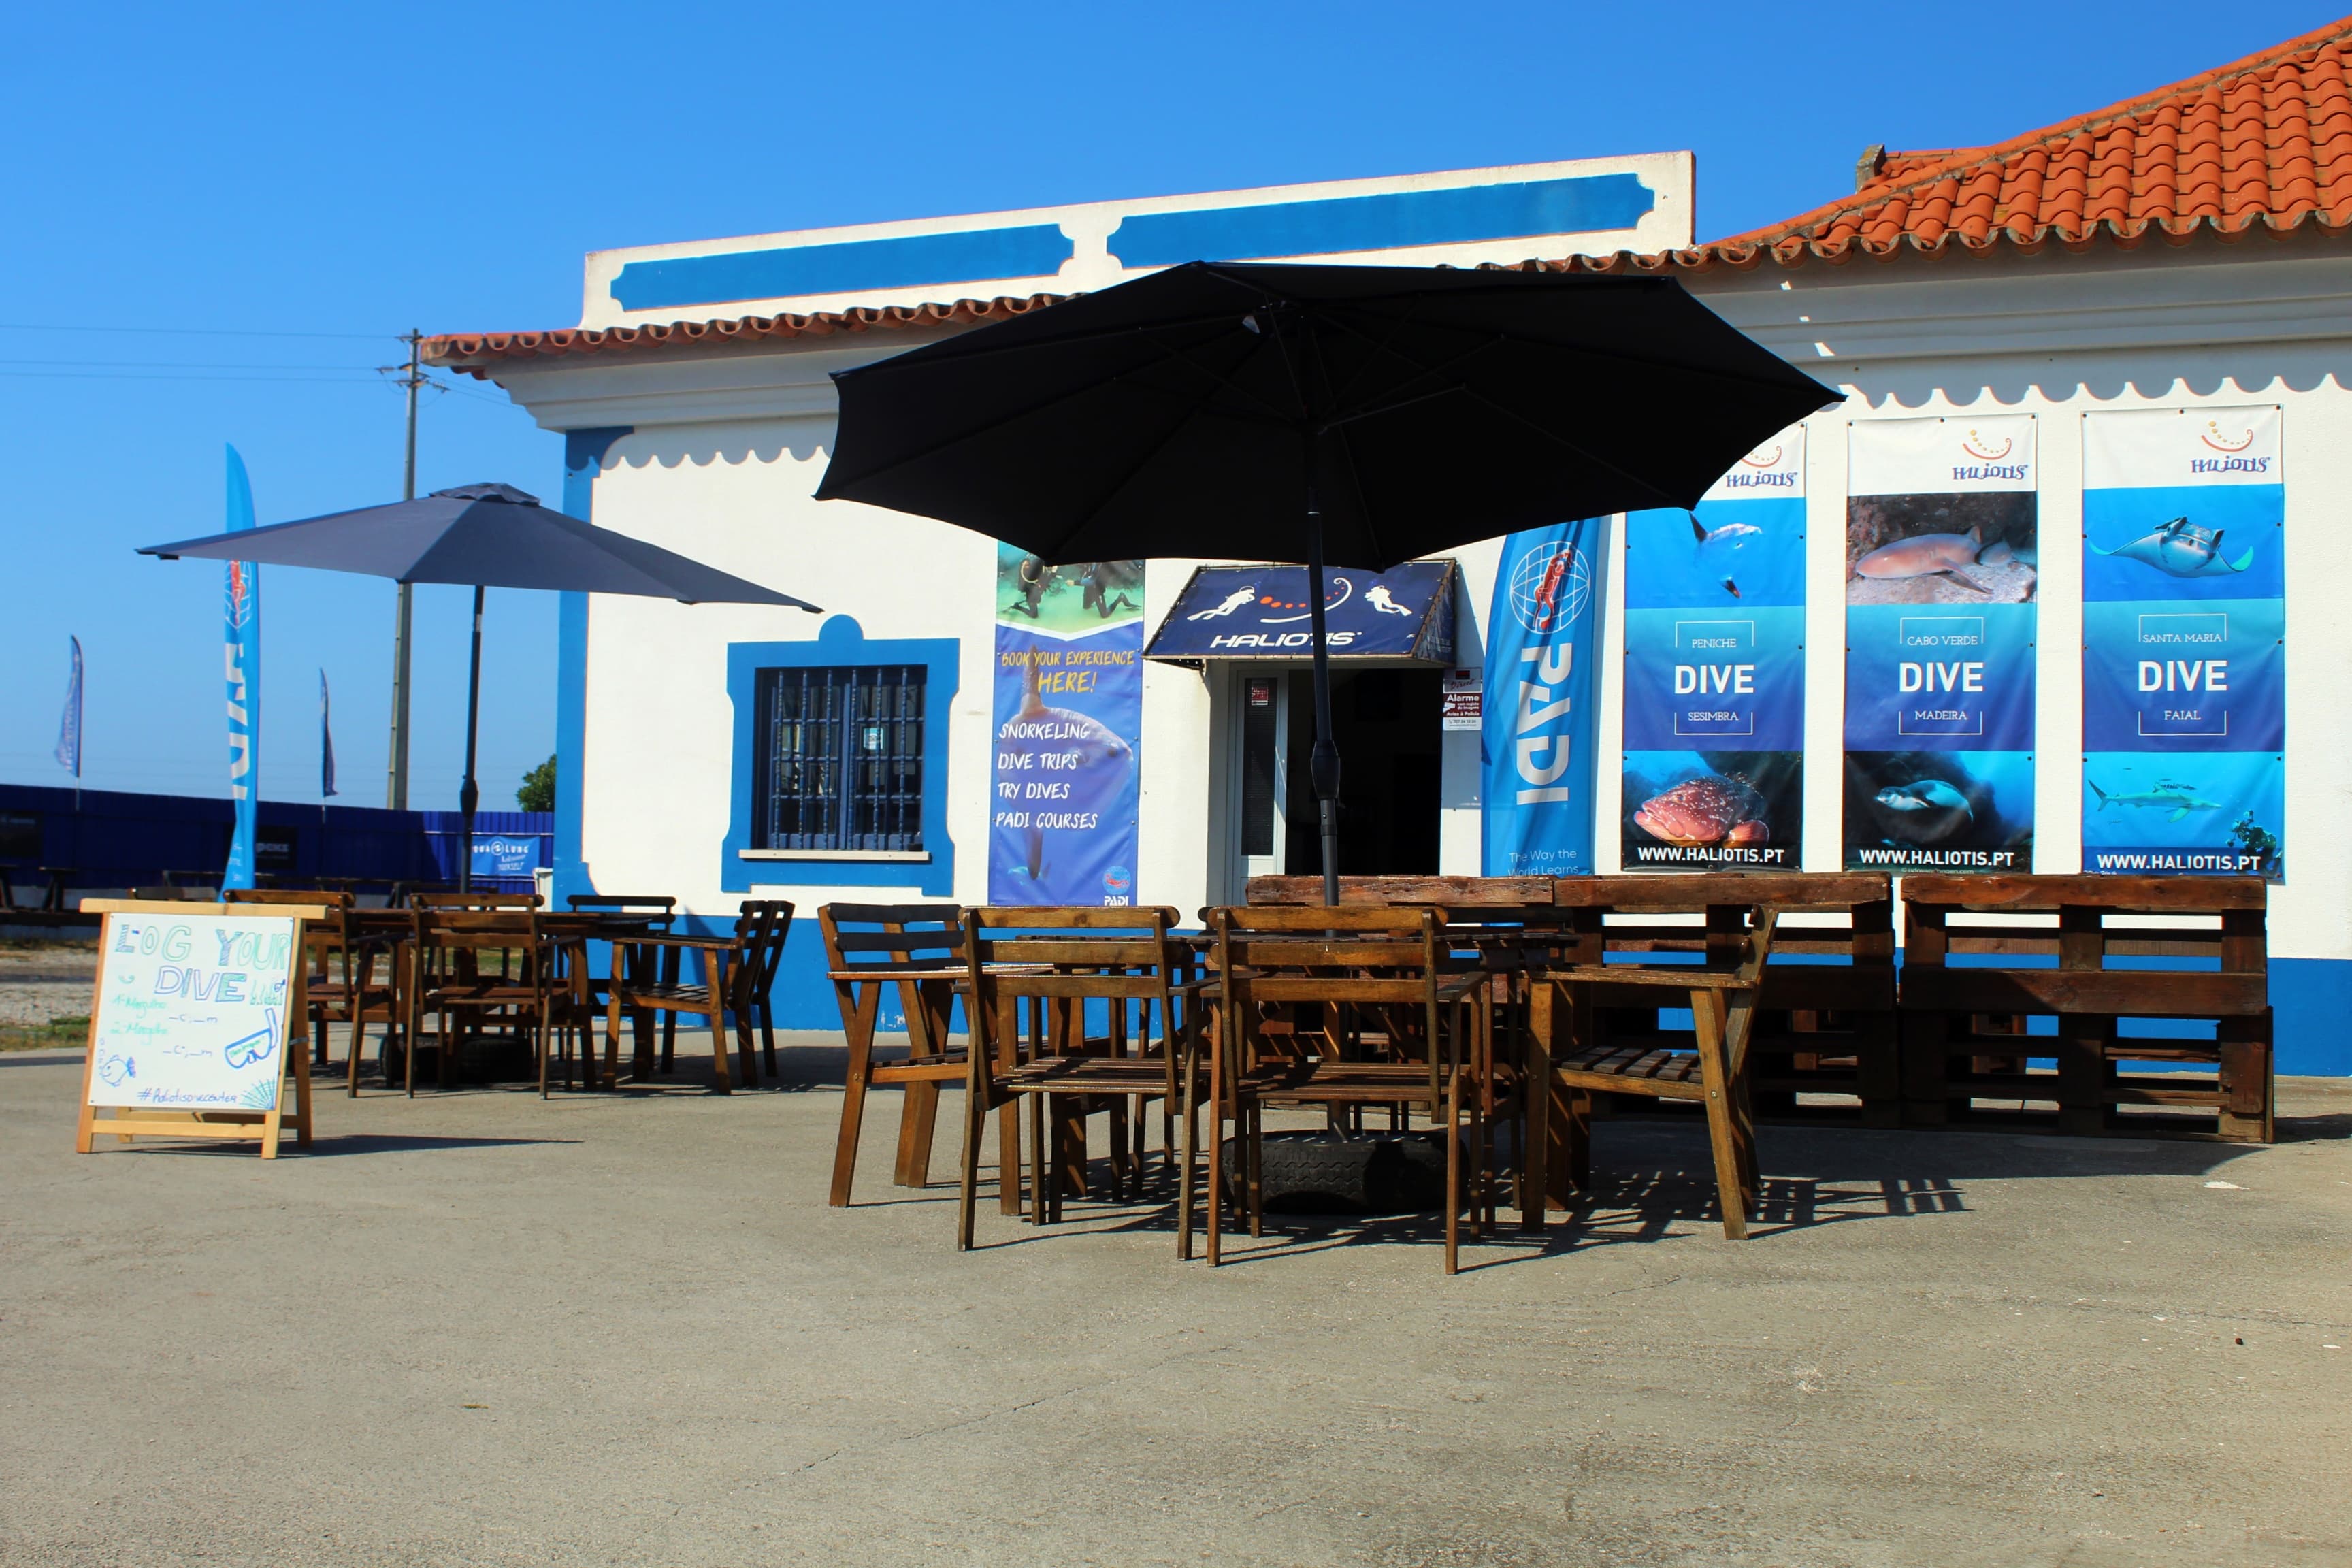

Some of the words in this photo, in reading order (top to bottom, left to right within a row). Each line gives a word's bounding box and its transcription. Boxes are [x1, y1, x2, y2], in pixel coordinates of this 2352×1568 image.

[1692, 638, 1737, 649] PENICHE
[1907, 636, 1938, 646] CABO
[1942, 636, 1978, 645] VERDE
[2142, 634, 2182, 643] SANTA
[2185, 633, 2222, 642] MARIA
[1002, 652, 1030, 666] BOOK
[1033, 651, 1061, 666] YOUR
[1066, 650, 1135, 666] EXPERIENCE
[1038, 671, 1098, 693] HERE!
[1674, 664, 1754, 694] DIVE
[1899, 662, 1984, 692] DIVE
[2138, 660, 2228, 691] DIVE
[1688, 712, 1739, 721] SESIMBRA
[1914, 710, 1968, 720] MADEIRA
[2164, 710, 2202, 721] FAIAL
[998, 723, 1090, 740] SNORKELING
[1516, 642, 1573, 805] PADI
[998, 753, 1034, 770] DIVE
[1040, 753, 1079, 770] TRIPS
[998, 782, 1021, 800] TRY
[1026, 782, 1071, 799] DIVES
[996, 811, 1030, 828] PADI
[1036, 812, 1098, 829] COURSES
[1508, 851, 1528, 863] The
[1530, 850, 1555, 862] Way
[1558, 849, 1577, 859] the
[1637, 847, 1785, 863] WWW.HALIOTIS.PT
[1859, 849, 2015, 866] WWW.HALIOTIS.PT
[2097, 854, 2261, 870] WWW.HALIOTIS.PT
[1541, 865, 1579, 875] Learns
[1105, 896, 1128, 906] PADI
[114, 924, 192, 962] LOG
[215, 928, 292, 970] YOUR
[154, 965, 248, 1002] DIVE
